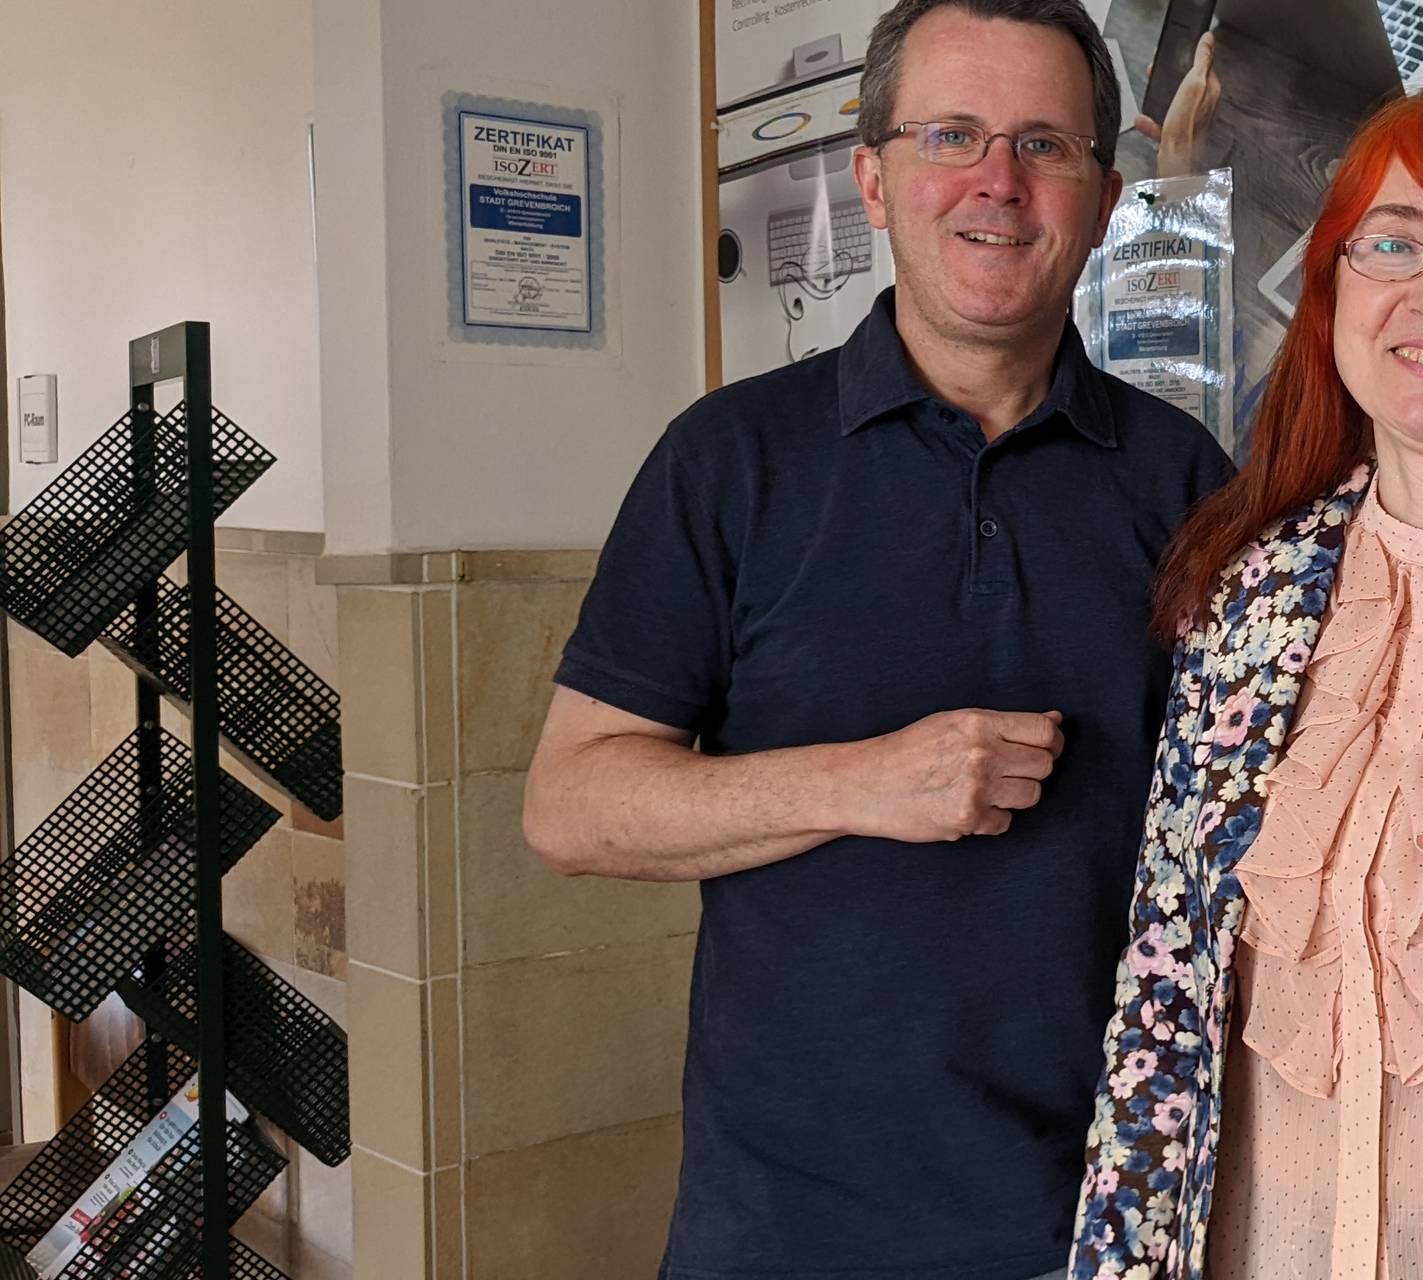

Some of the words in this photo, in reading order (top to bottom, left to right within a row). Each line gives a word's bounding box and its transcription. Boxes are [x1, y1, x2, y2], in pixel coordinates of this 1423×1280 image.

[474, 126, 575, 152] ZERTIFIKAT
[493, 145, 507, 153] DIN
[510, 147, 520, 155] EN
[523, 148, 537, 156] ISO
[480, 196, 505, 206] STADT
[507, 199, 571, 212] GREVENBROICH
[1113, 238, 1192, 261] ZERTIFIKAT
